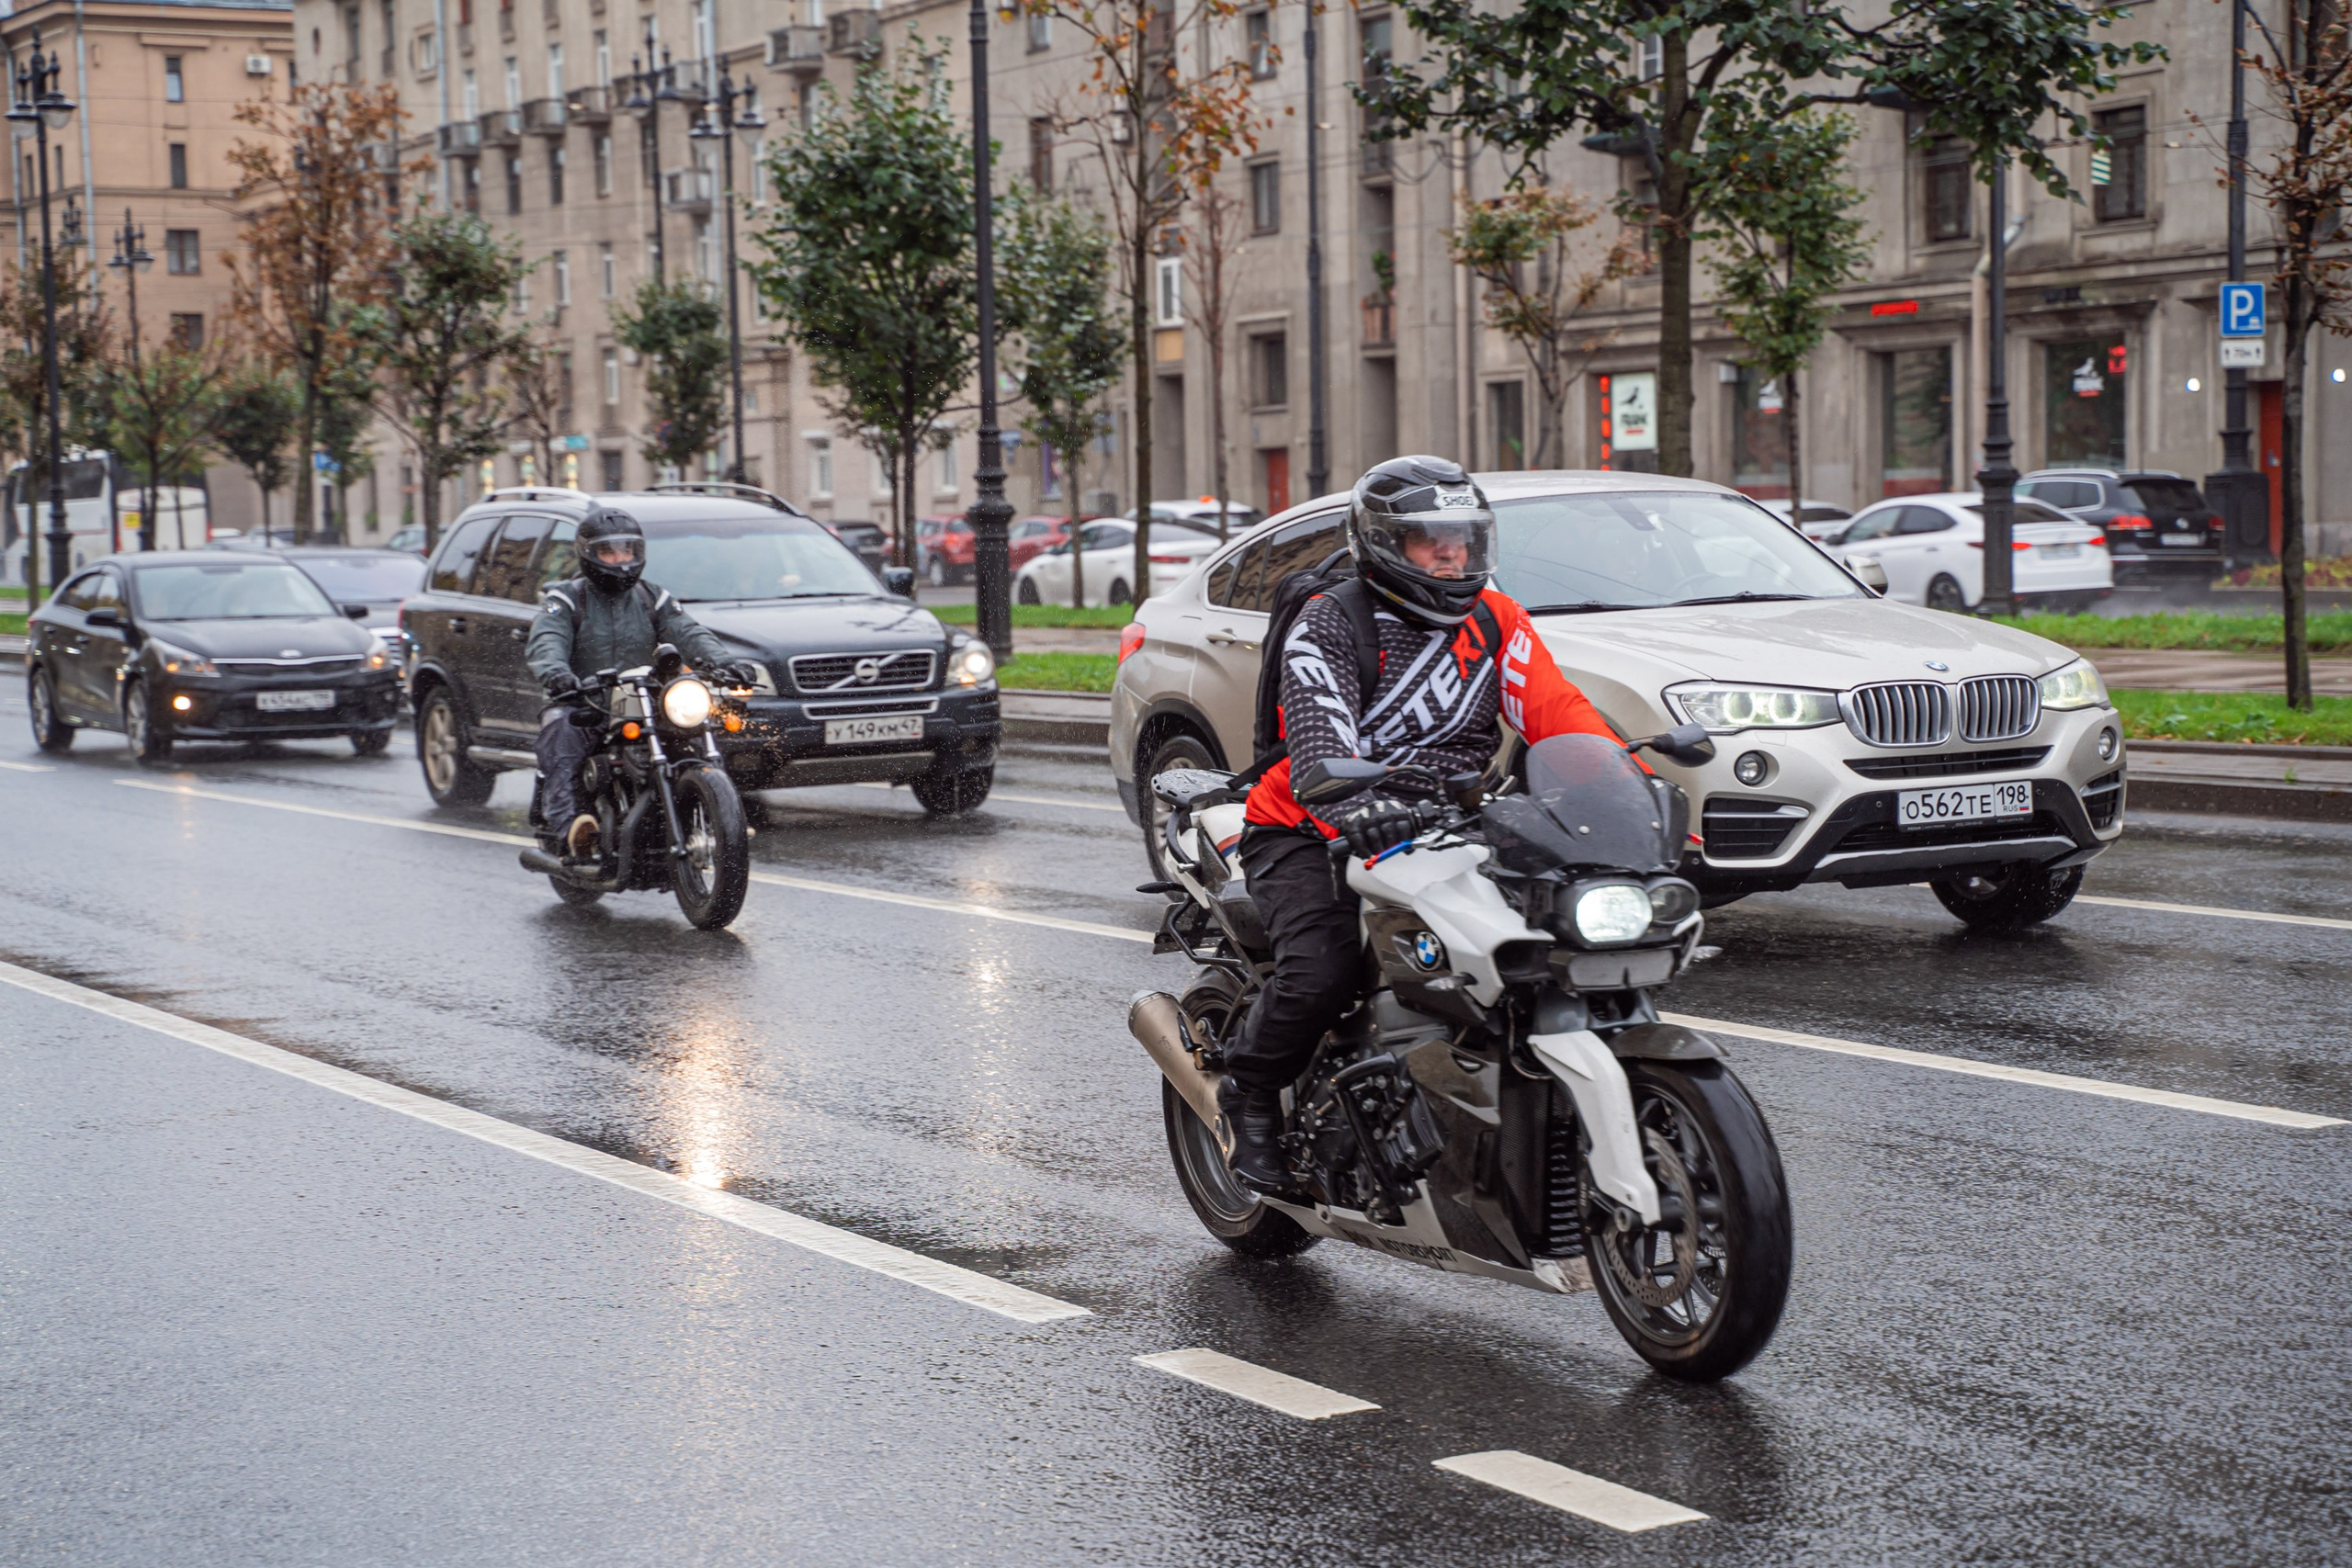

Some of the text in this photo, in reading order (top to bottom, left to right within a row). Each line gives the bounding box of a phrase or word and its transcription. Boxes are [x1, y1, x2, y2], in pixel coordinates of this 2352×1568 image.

[2231, 288, 2255, 330] P
[1996, 784, 2027, 806] 198
[2003, 804, 2019, 813] RUS
